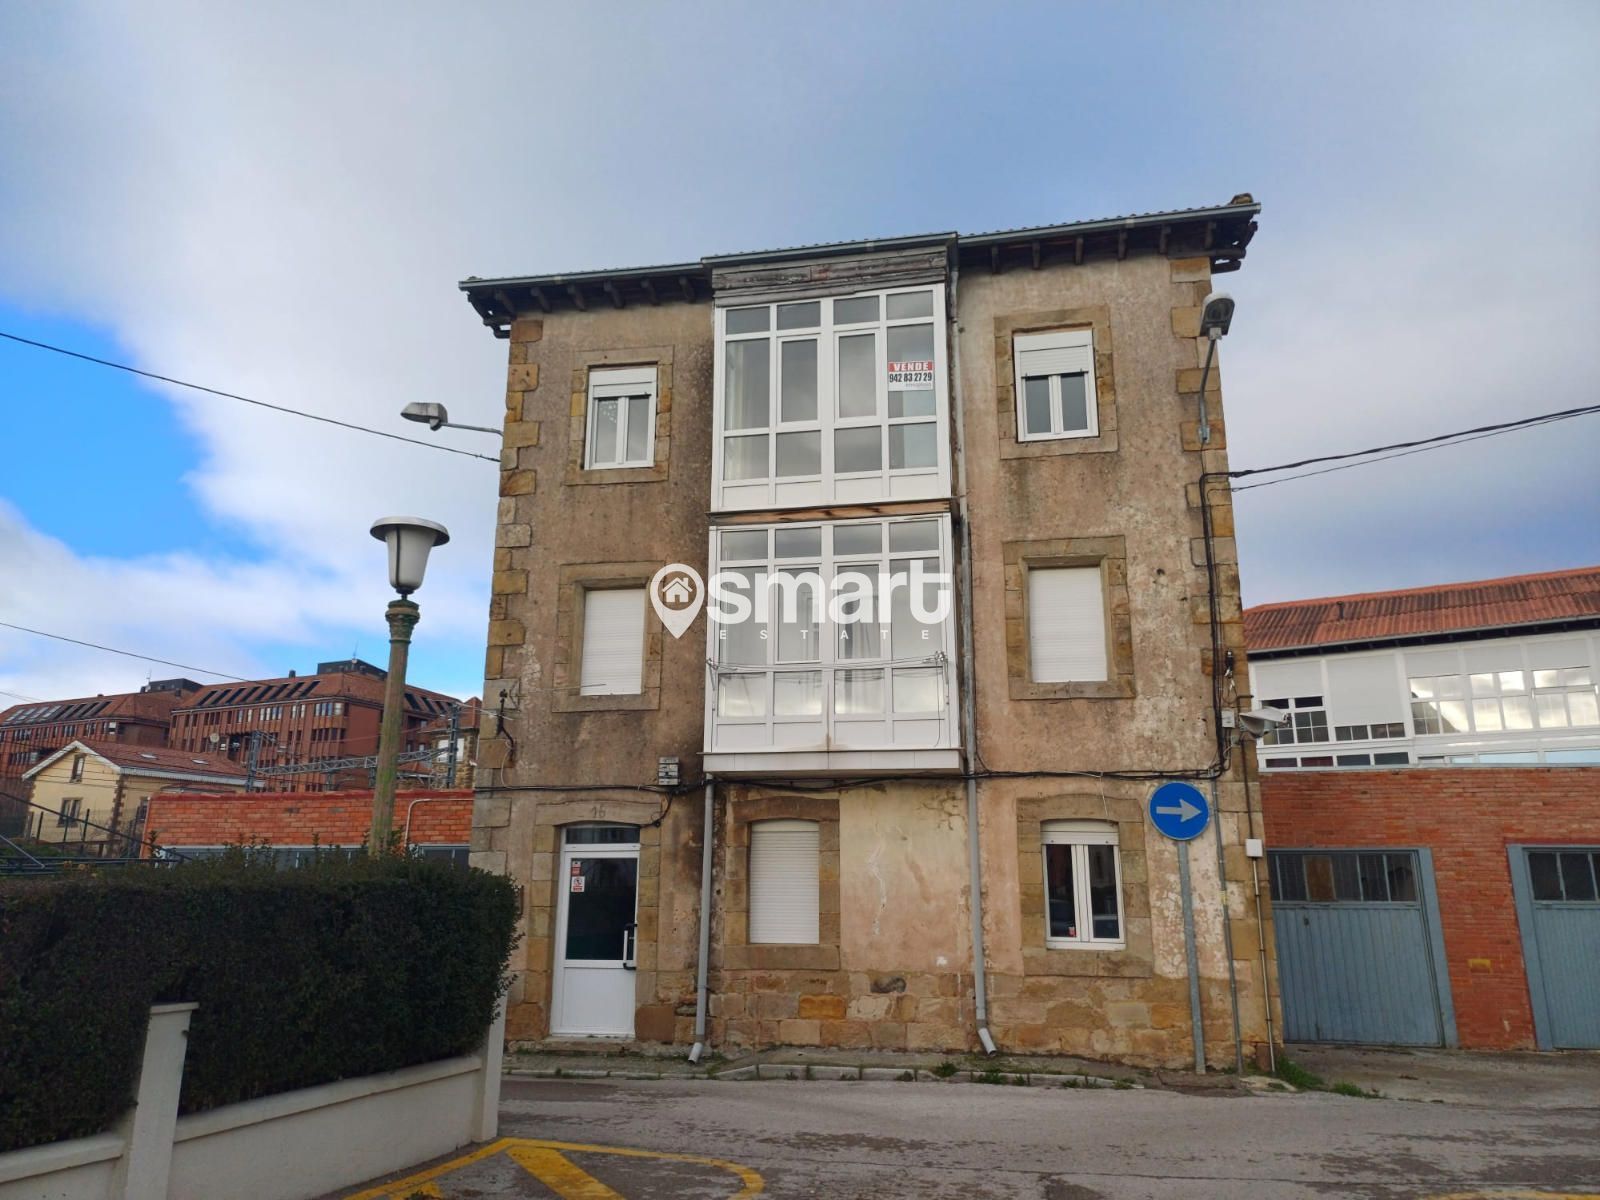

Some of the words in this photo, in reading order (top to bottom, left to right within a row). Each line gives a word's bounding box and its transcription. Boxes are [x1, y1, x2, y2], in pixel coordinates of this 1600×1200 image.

[894, 361, 929, 371] VENDE
[889, 373, 902, 383] 942
[903, 372, 913, 382] 83
[914, 372, 922, 382] 27
[923, 372, 933, 382] 29
